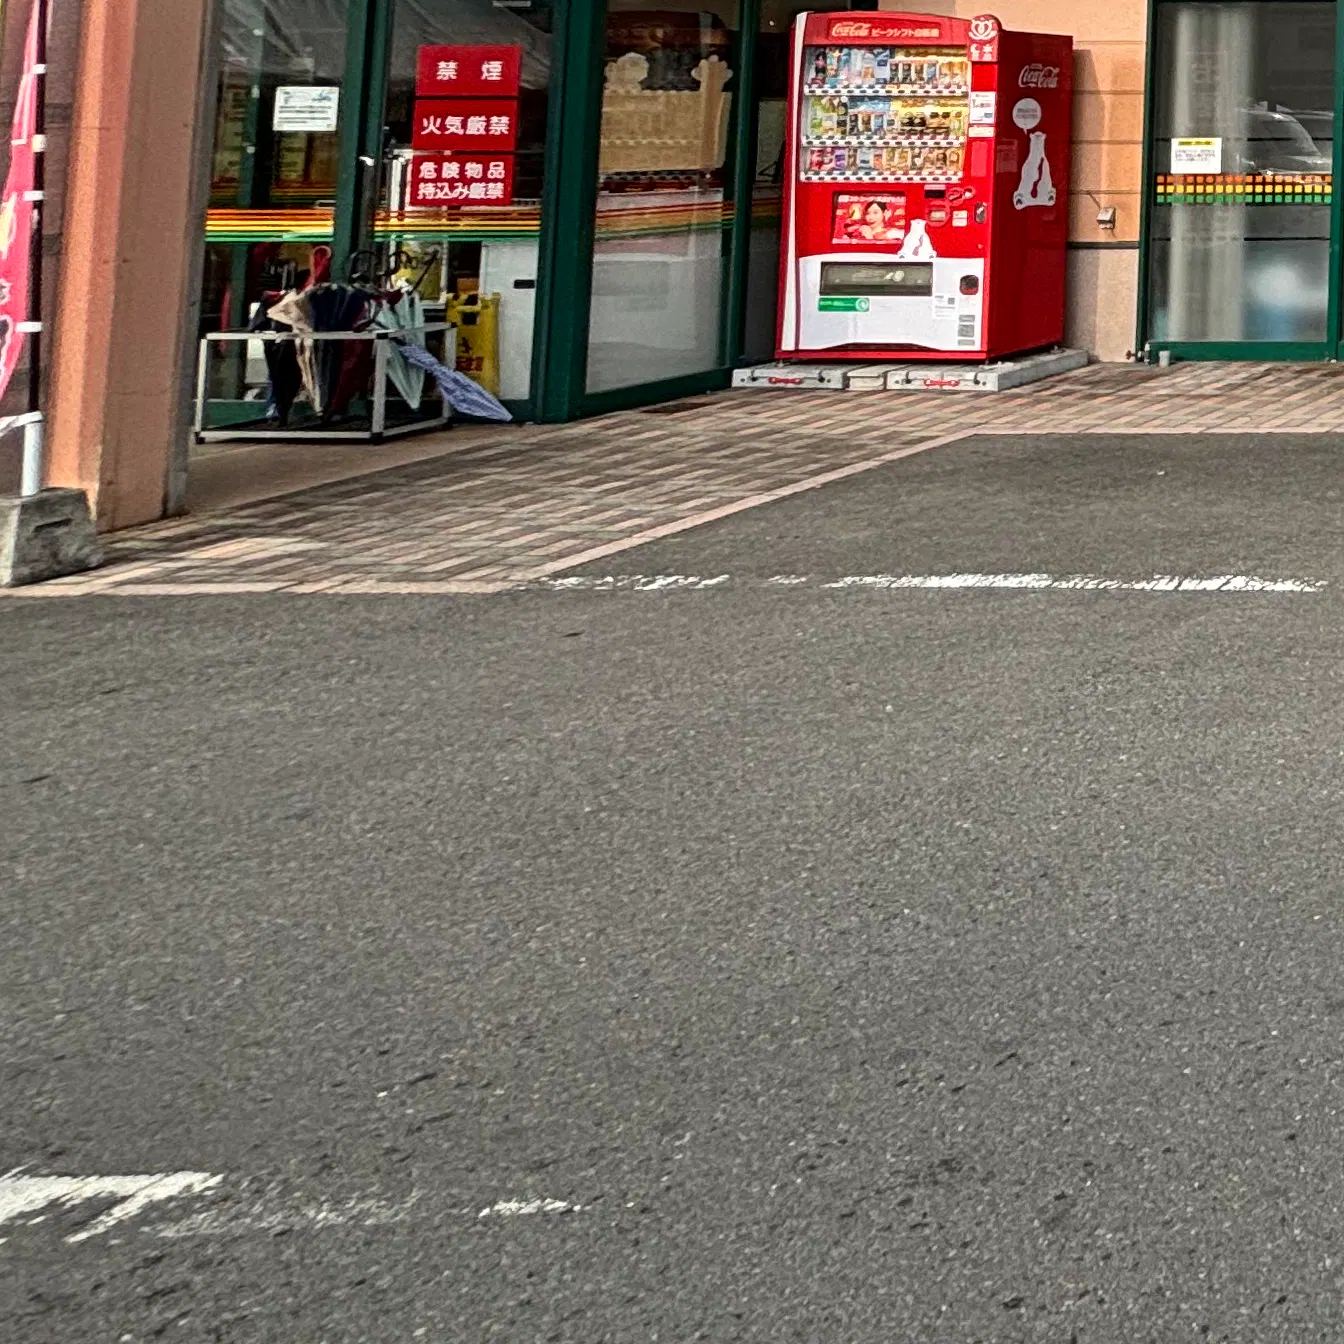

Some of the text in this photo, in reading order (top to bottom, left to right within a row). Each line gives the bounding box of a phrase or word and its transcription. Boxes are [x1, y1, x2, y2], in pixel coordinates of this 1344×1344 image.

[832, 21, 872, 37] Coca-Cola
[436, 60, 503, 81] 禁煙
[1018, 64, 1061, 88] Coca-Cola
[421, 115, 510, 135] 火気厳禁
[418, 161, 505, 179] 危険物品
[417, 182, 504, 200] 持込み厳禁
